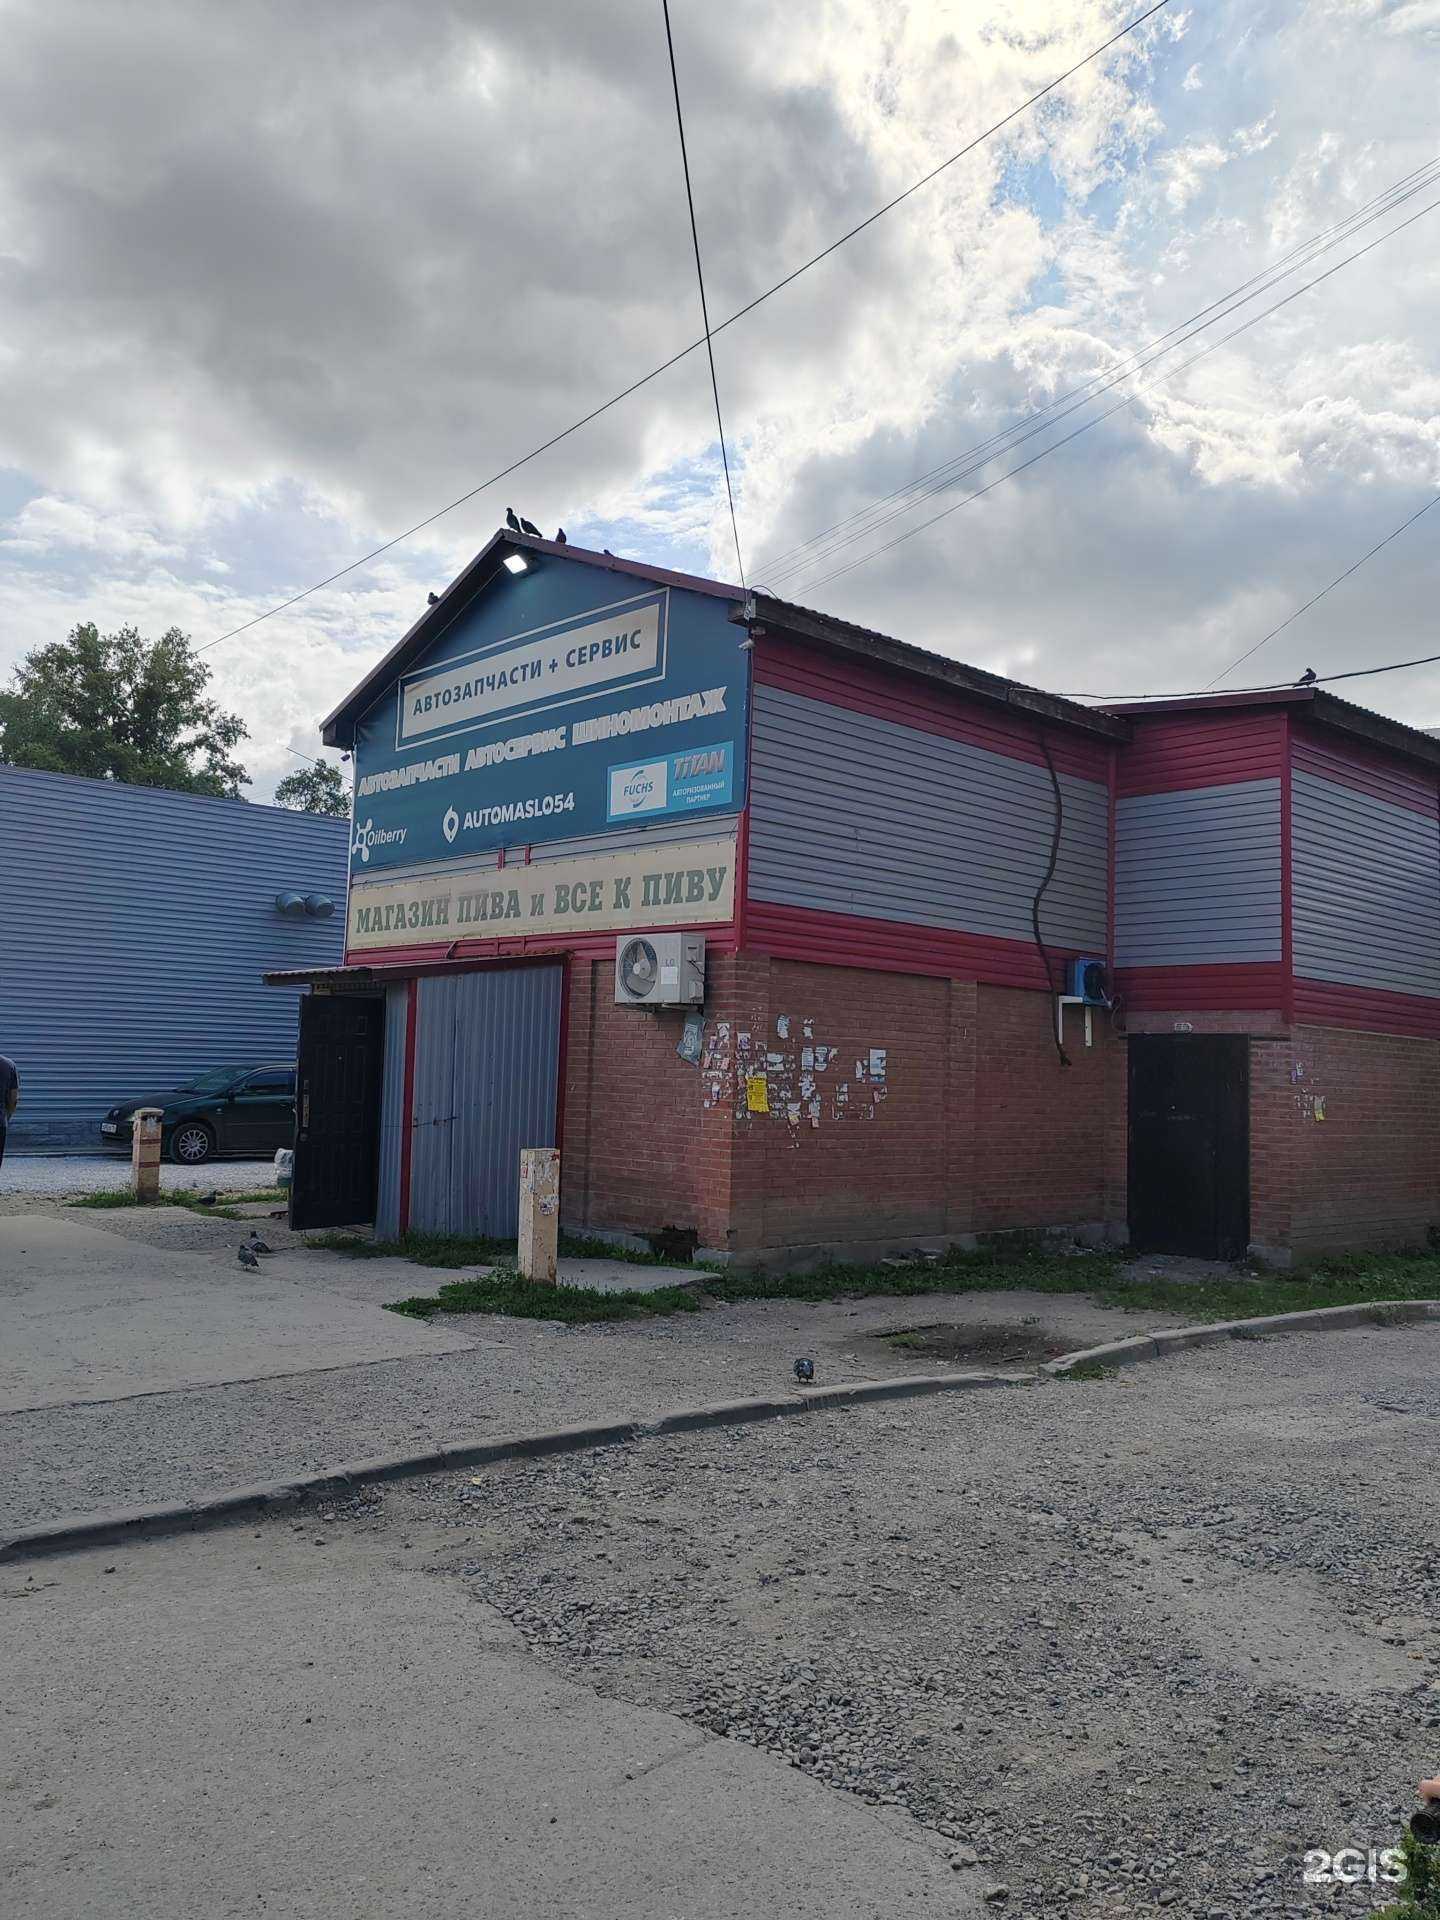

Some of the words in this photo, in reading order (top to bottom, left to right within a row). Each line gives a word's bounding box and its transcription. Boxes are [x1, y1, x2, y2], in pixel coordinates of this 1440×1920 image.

[413, 660, 542, 716] АВТОЗАПЧАСТИ
[566, 629, 642, 668] СЕРВИС
[357, 753, 460, 797] АВТОЗАПЧАСТИ
[464, 726, 567, 771] АВТОСЕРВИС
[572, 686, 728, 746] ШИНОМОНТАЖ
[463, 792, 576, 831] AUTOMASLO54
[624, 781, 655, 797] FUCHS
[367, 828, 408, 846] Oilberry
[356, 895, 450, 934] МАГАЗИН
[456, 889, 522, 924] ПИВА
[554, 880, 604, 914] ВСЕ
[613, 876, 632, 910] К
[641, 866, 728, 907] ПИВУ
